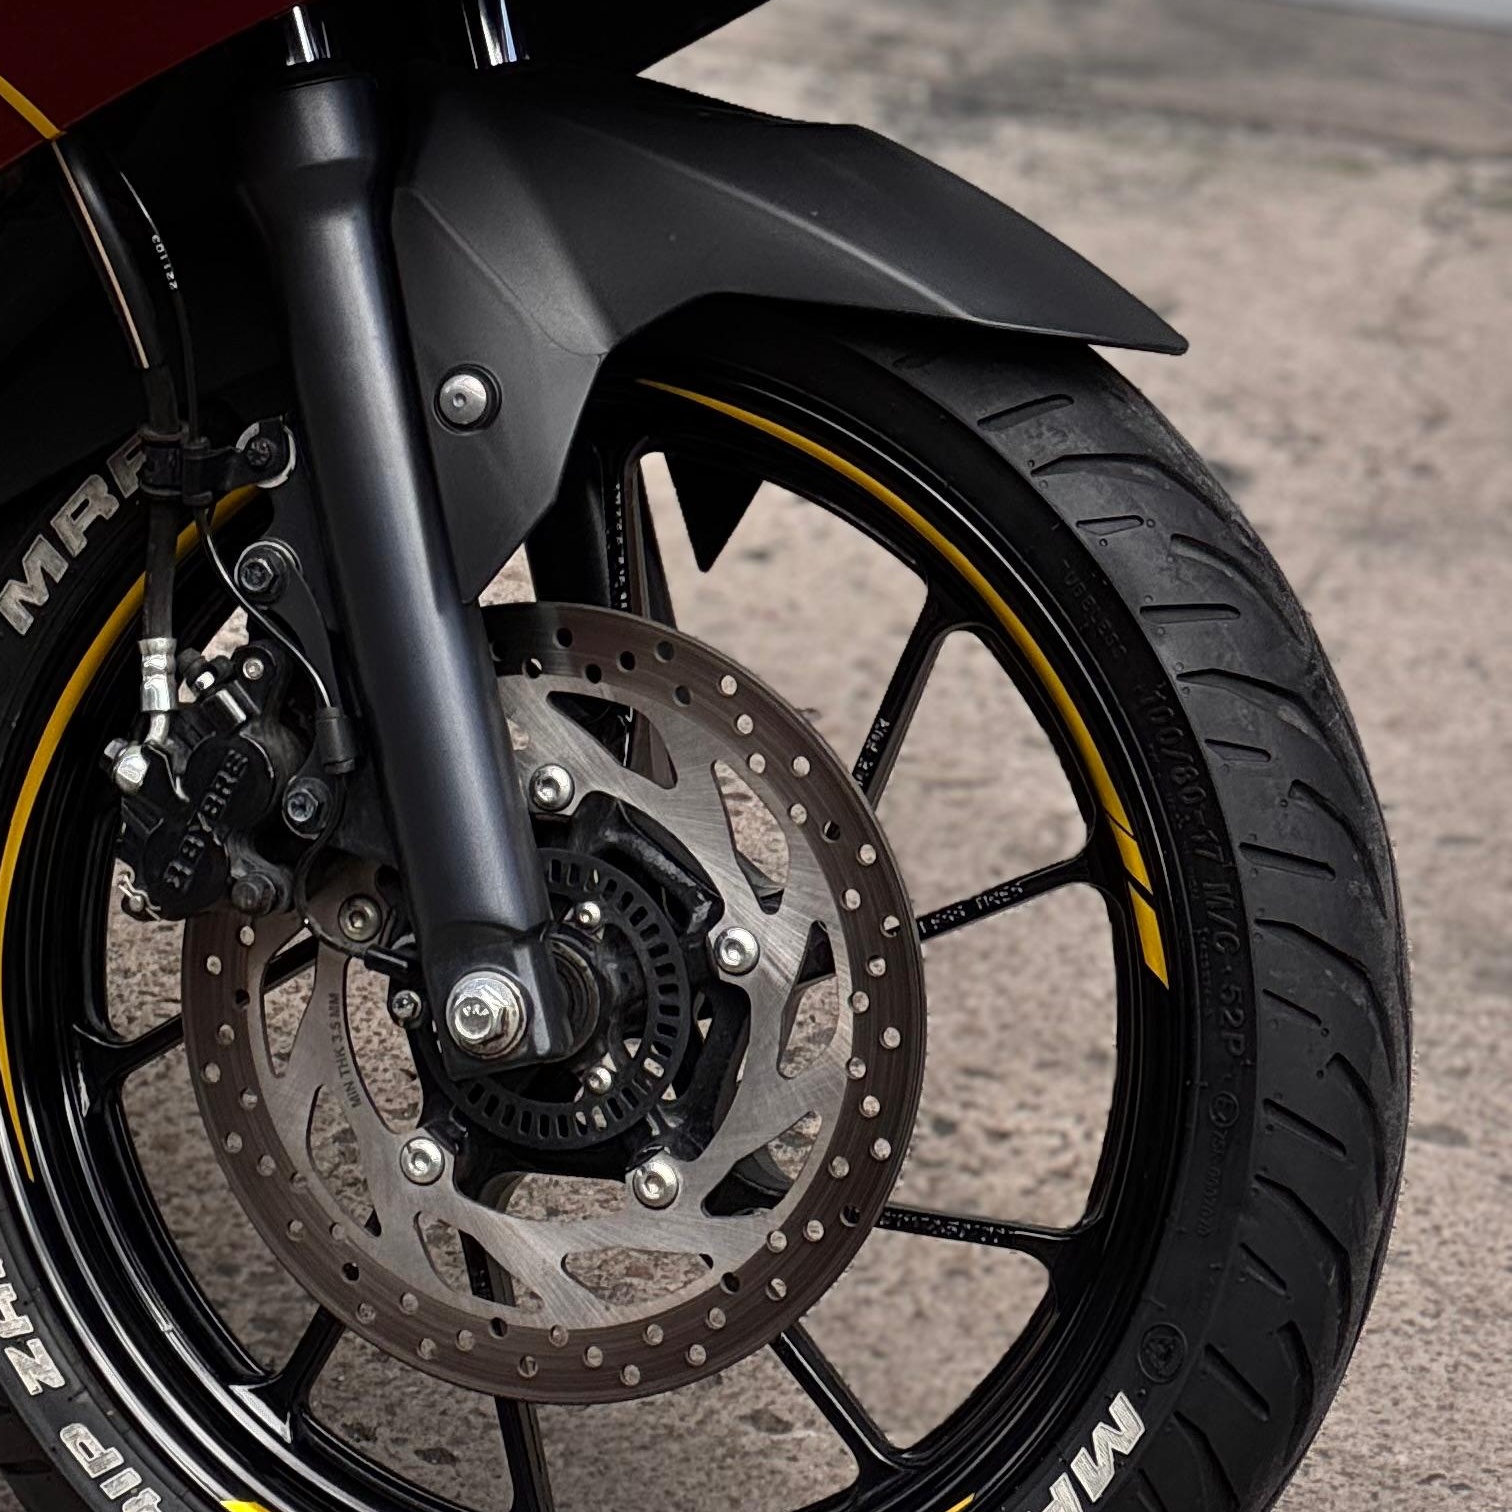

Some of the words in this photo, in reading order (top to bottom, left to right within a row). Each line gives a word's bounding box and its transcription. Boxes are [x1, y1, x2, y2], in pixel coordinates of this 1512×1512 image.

[328, 993, 340, 1018] MM
[334, 1047, 350, 1078] THK
[344, 1081, 362, 1108] MIN
